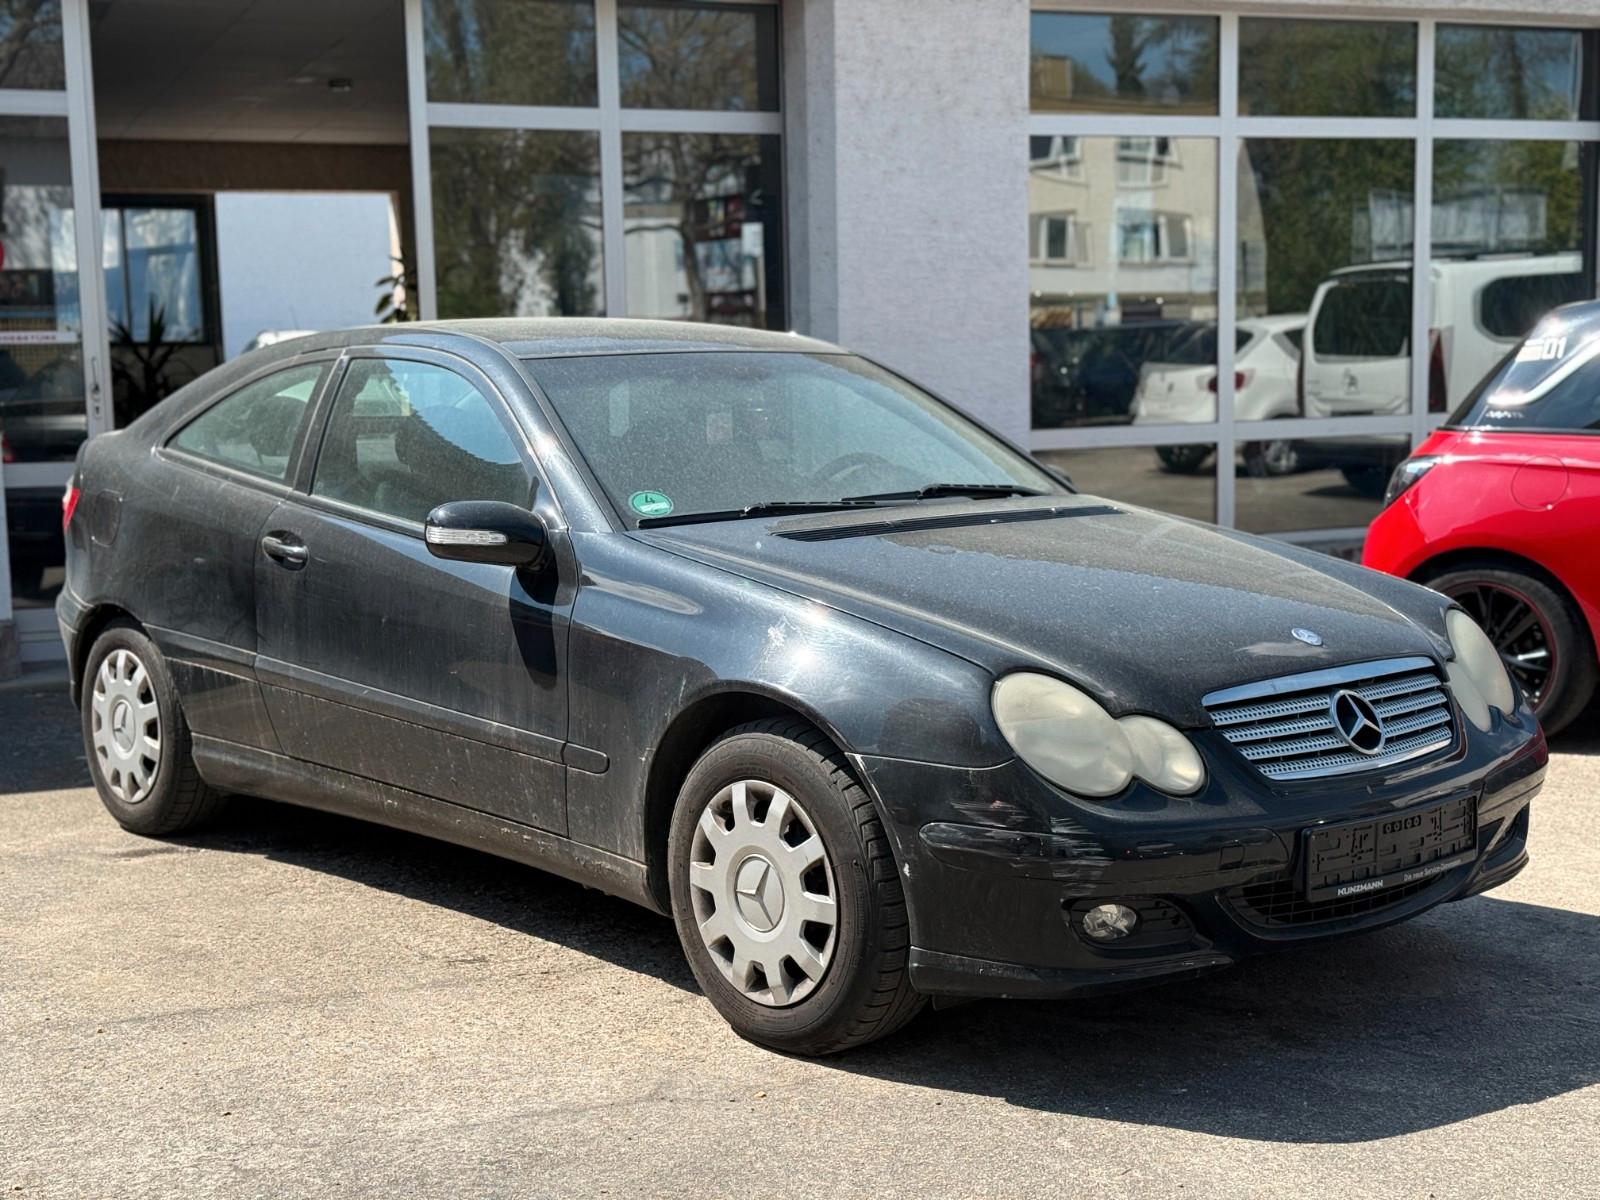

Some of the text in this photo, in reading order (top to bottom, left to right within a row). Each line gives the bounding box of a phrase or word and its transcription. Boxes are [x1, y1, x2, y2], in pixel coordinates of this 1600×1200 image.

[645, 494, 656, 504] 4
[1403, 873, 1412, 882] Die
[1337, 879, 1384, 896] KUNZMANN
